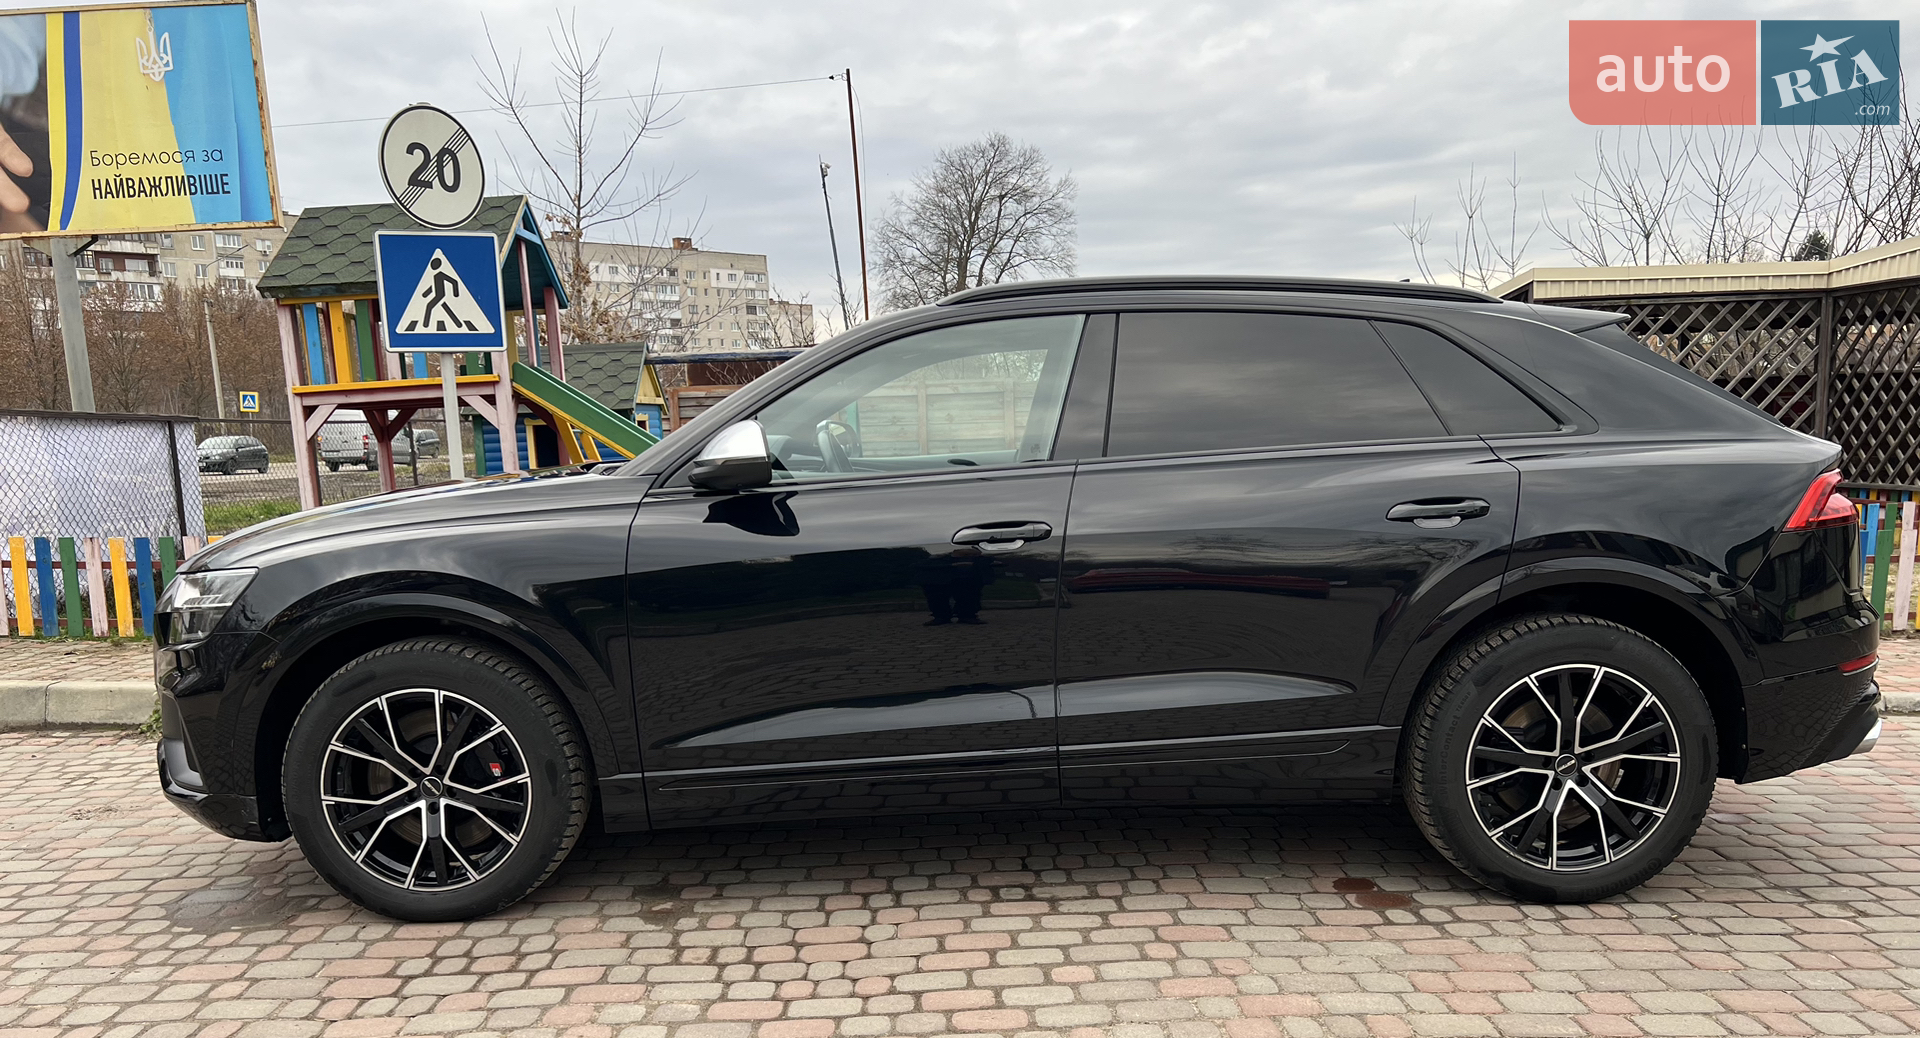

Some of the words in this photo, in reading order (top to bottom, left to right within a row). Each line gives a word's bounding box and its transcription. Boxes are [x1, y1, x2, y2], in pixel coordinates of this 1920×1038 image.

[90, 150, 196, 169] Боремося
[202, 149, 224, 163] за
[405, 141, 461, 193] 20
[91, 173, 231, 200] НАЙВАЖЛИВІШЕ
